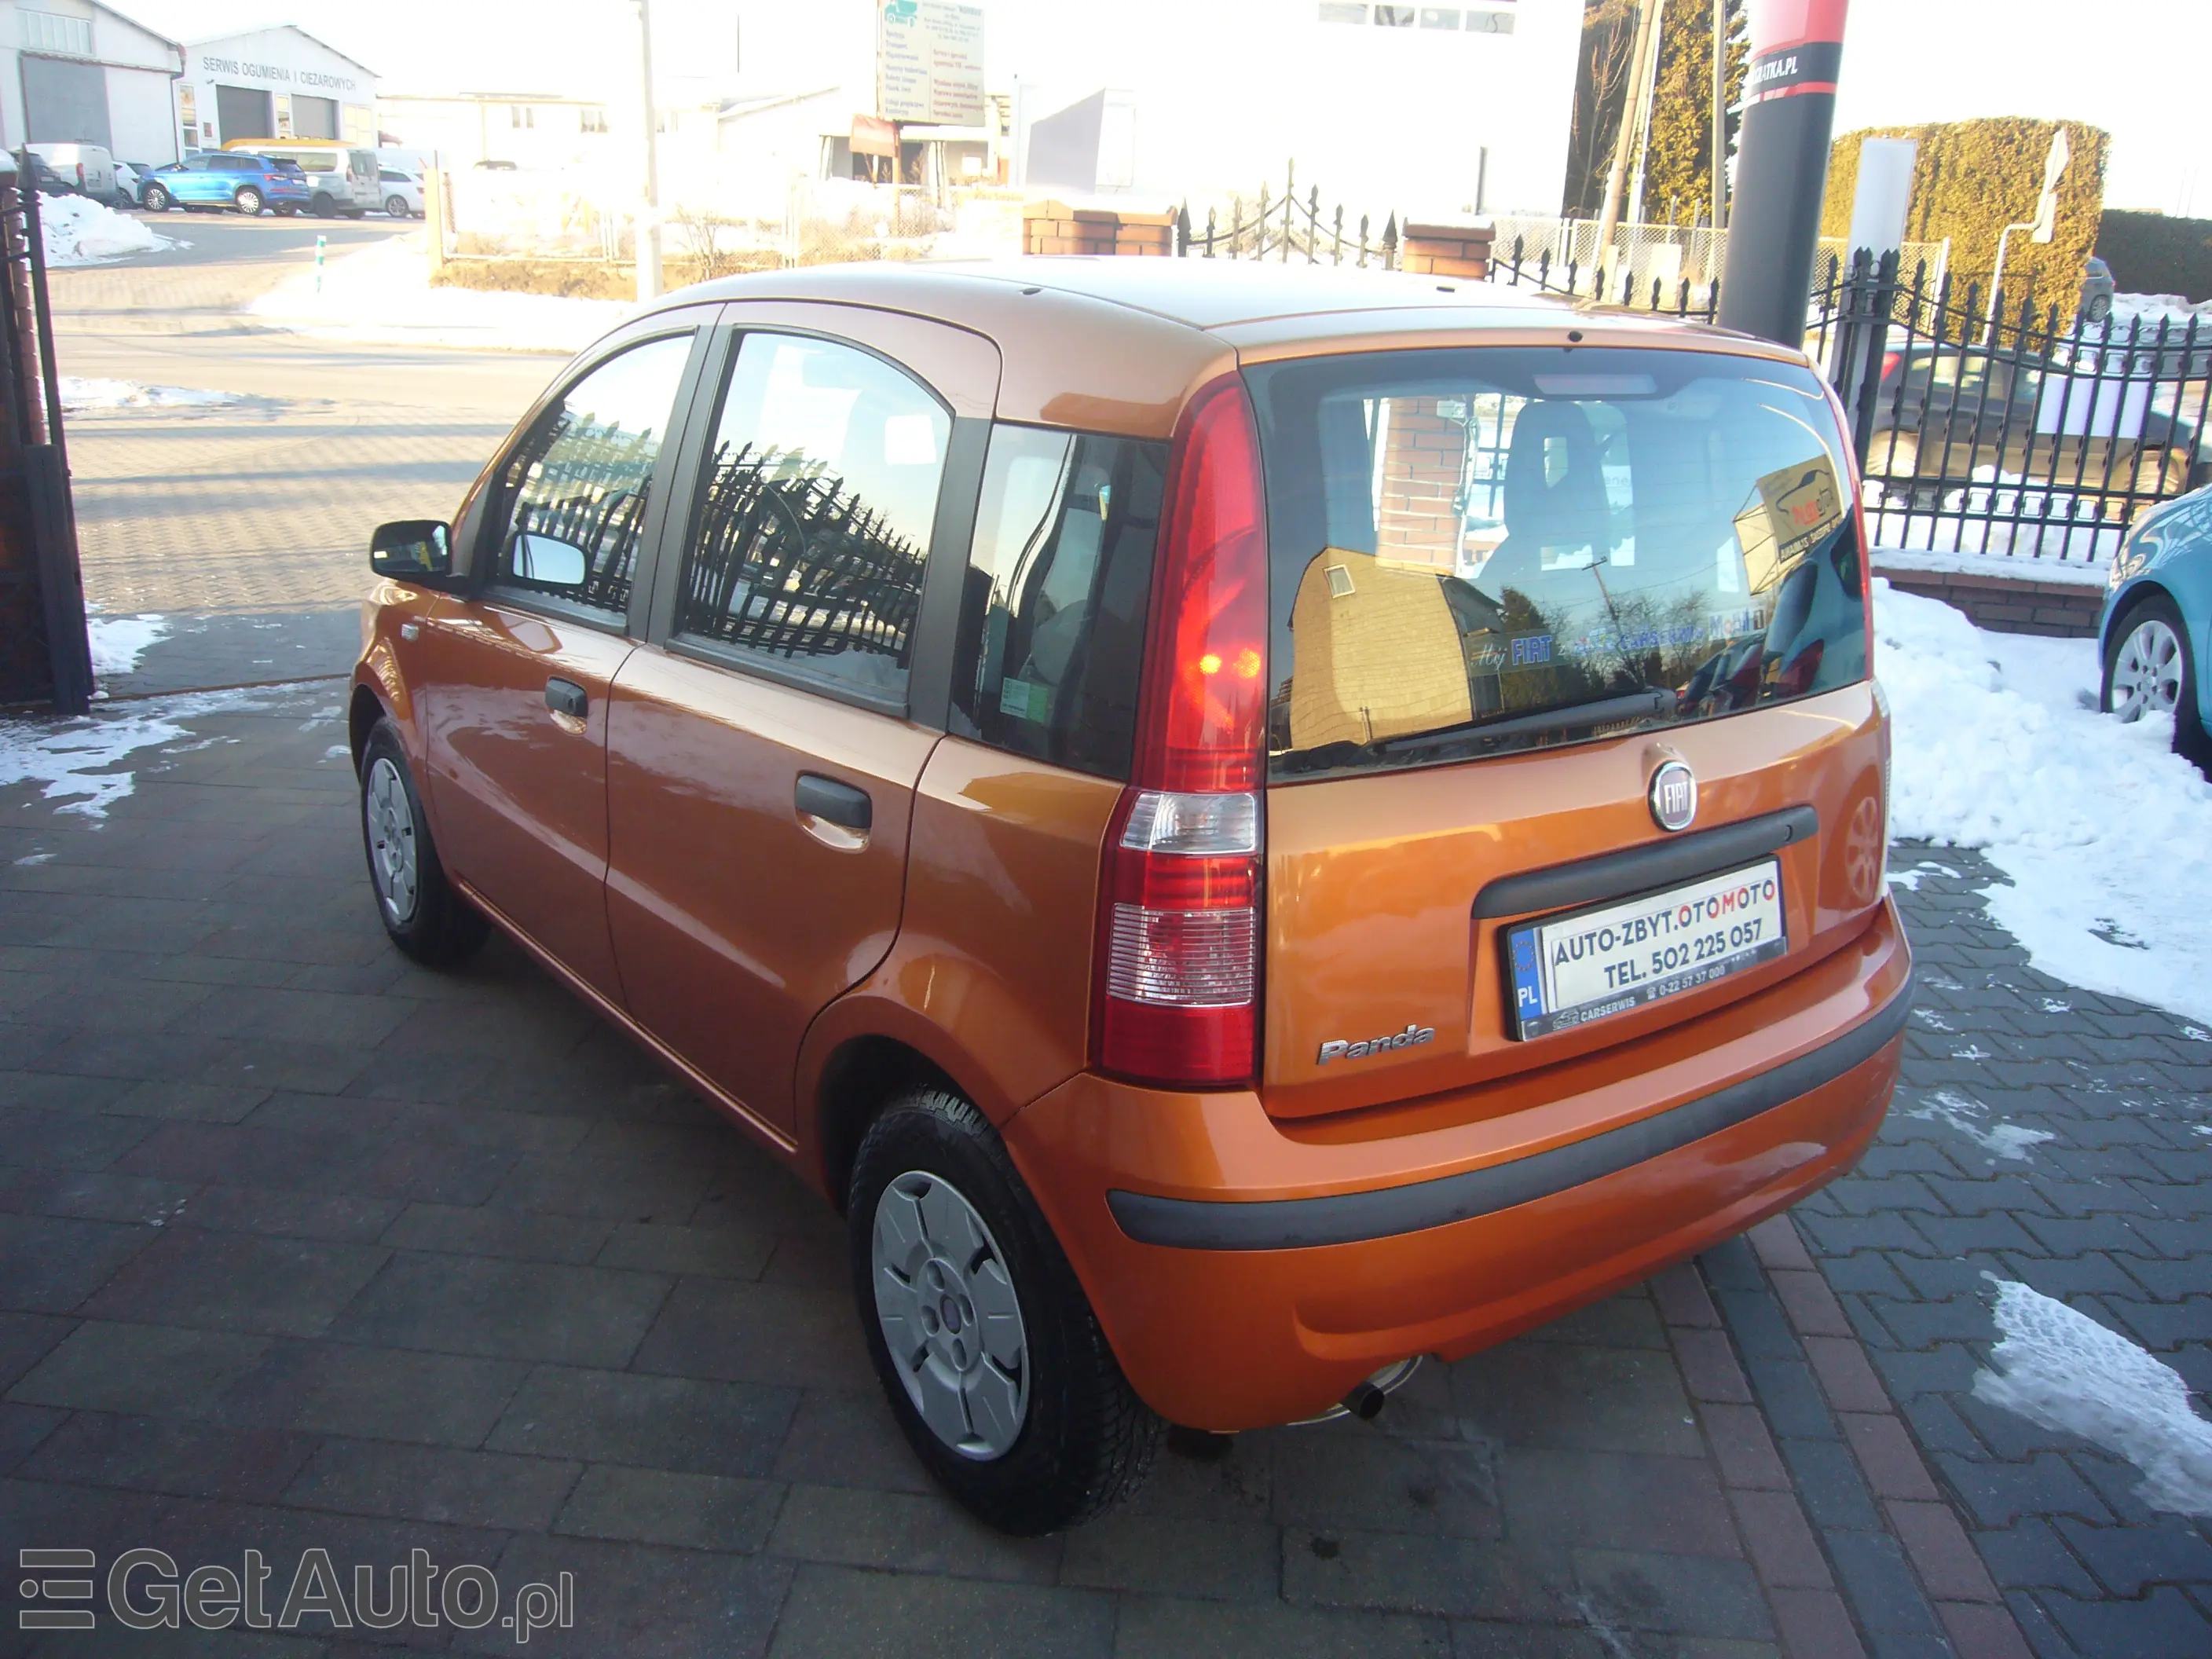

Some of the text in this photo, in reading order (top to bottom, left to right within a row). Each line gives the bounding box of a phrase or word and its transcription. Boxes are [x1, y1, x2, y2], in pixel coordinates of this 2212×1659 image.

[203, 57, 239, 75] SERWIS
[242, 62, 291, 82] OGUMIENIA
[1511, 635, 1552, 665] FIAT
[1664, 782, 1688, 814] FIAT
[1603, 959, 1646, 988] TEL.
[1652, 943, 1690, 974] 502
[1694, 931, 1726, 961] 225
[1730, 917, 1762, 947] 057
[1518, 986, 1538, 1007] PL
[1580, 996, 1635, 1022] CARSERWIS
[1659, 982, 1679, 996] 0-22
[1682, 976, 1693, 989] 57
[1696, 970, 1707, 983] 37
[1316, 1024, 1435, 1065] Panda
